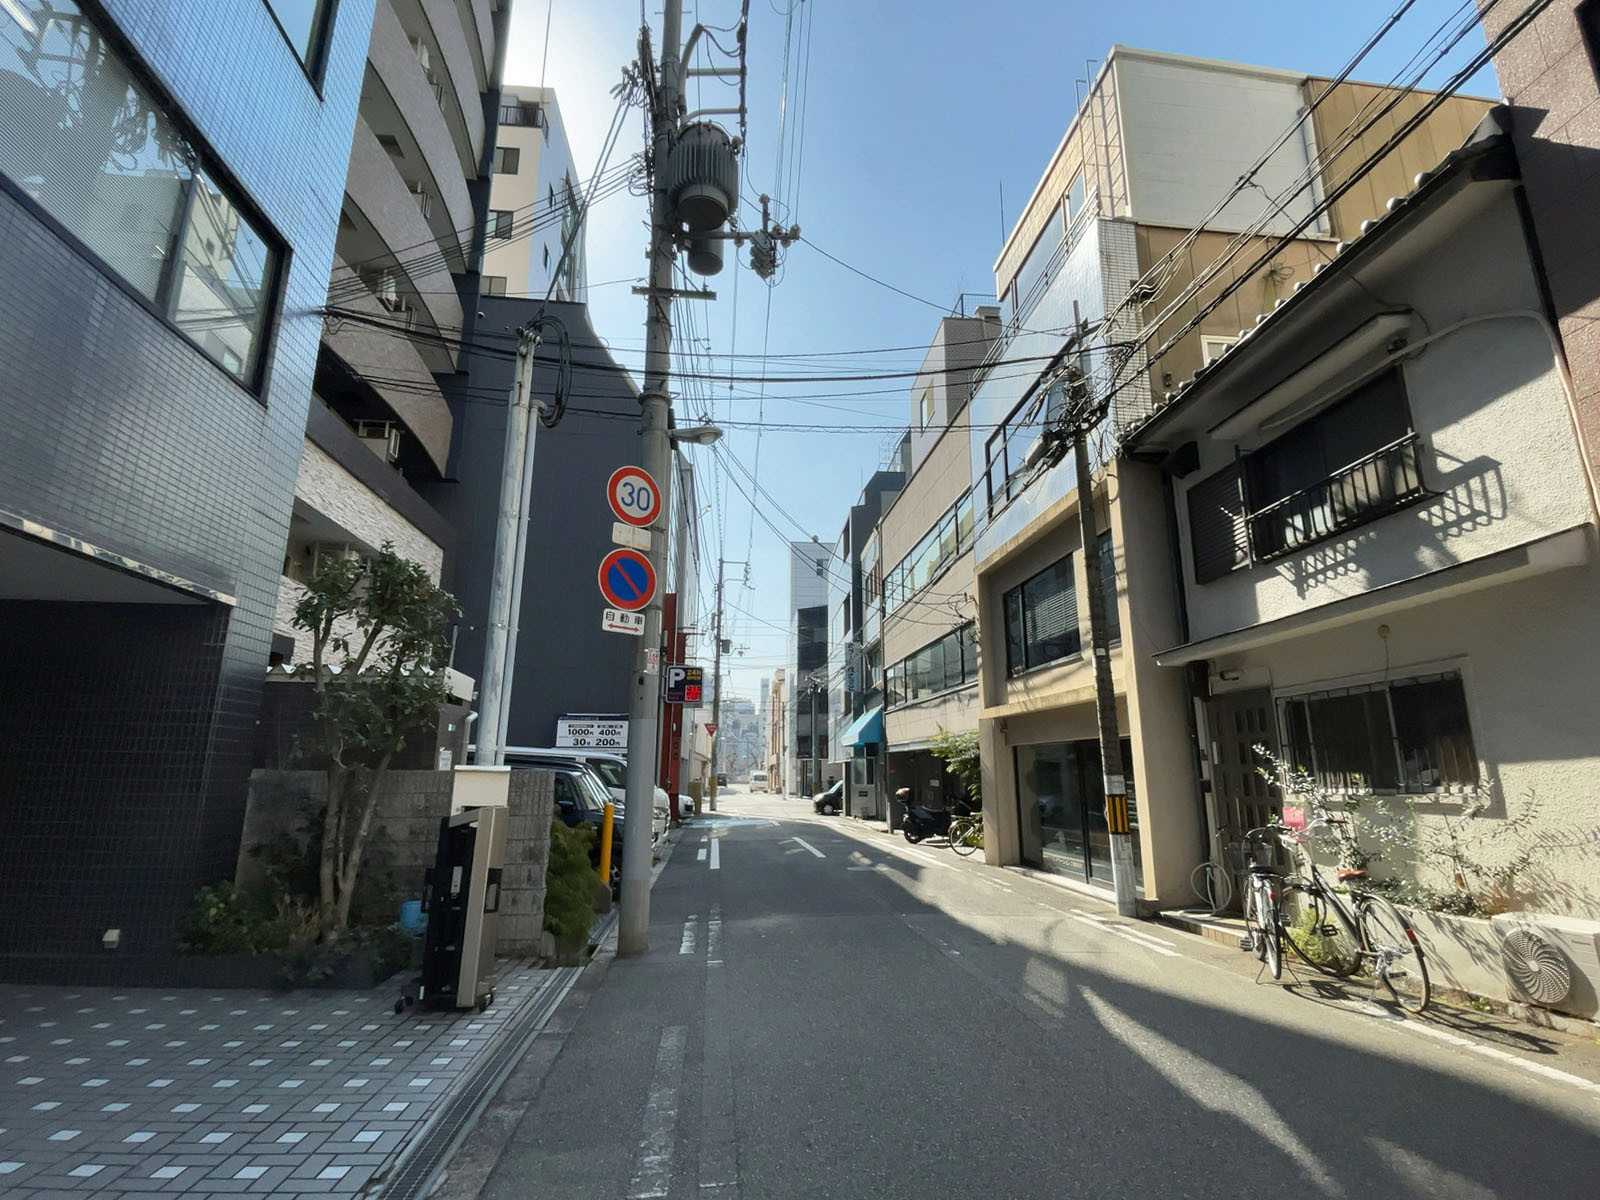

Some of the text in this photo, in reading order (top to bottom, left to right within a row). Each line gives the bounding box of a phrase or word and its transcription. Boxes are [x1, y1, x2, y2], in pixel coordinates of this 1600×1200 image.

[621, 482, 650, 511] 30
[605, 611, 643, 624] 自動車
[670, 668, 685, 688] P
